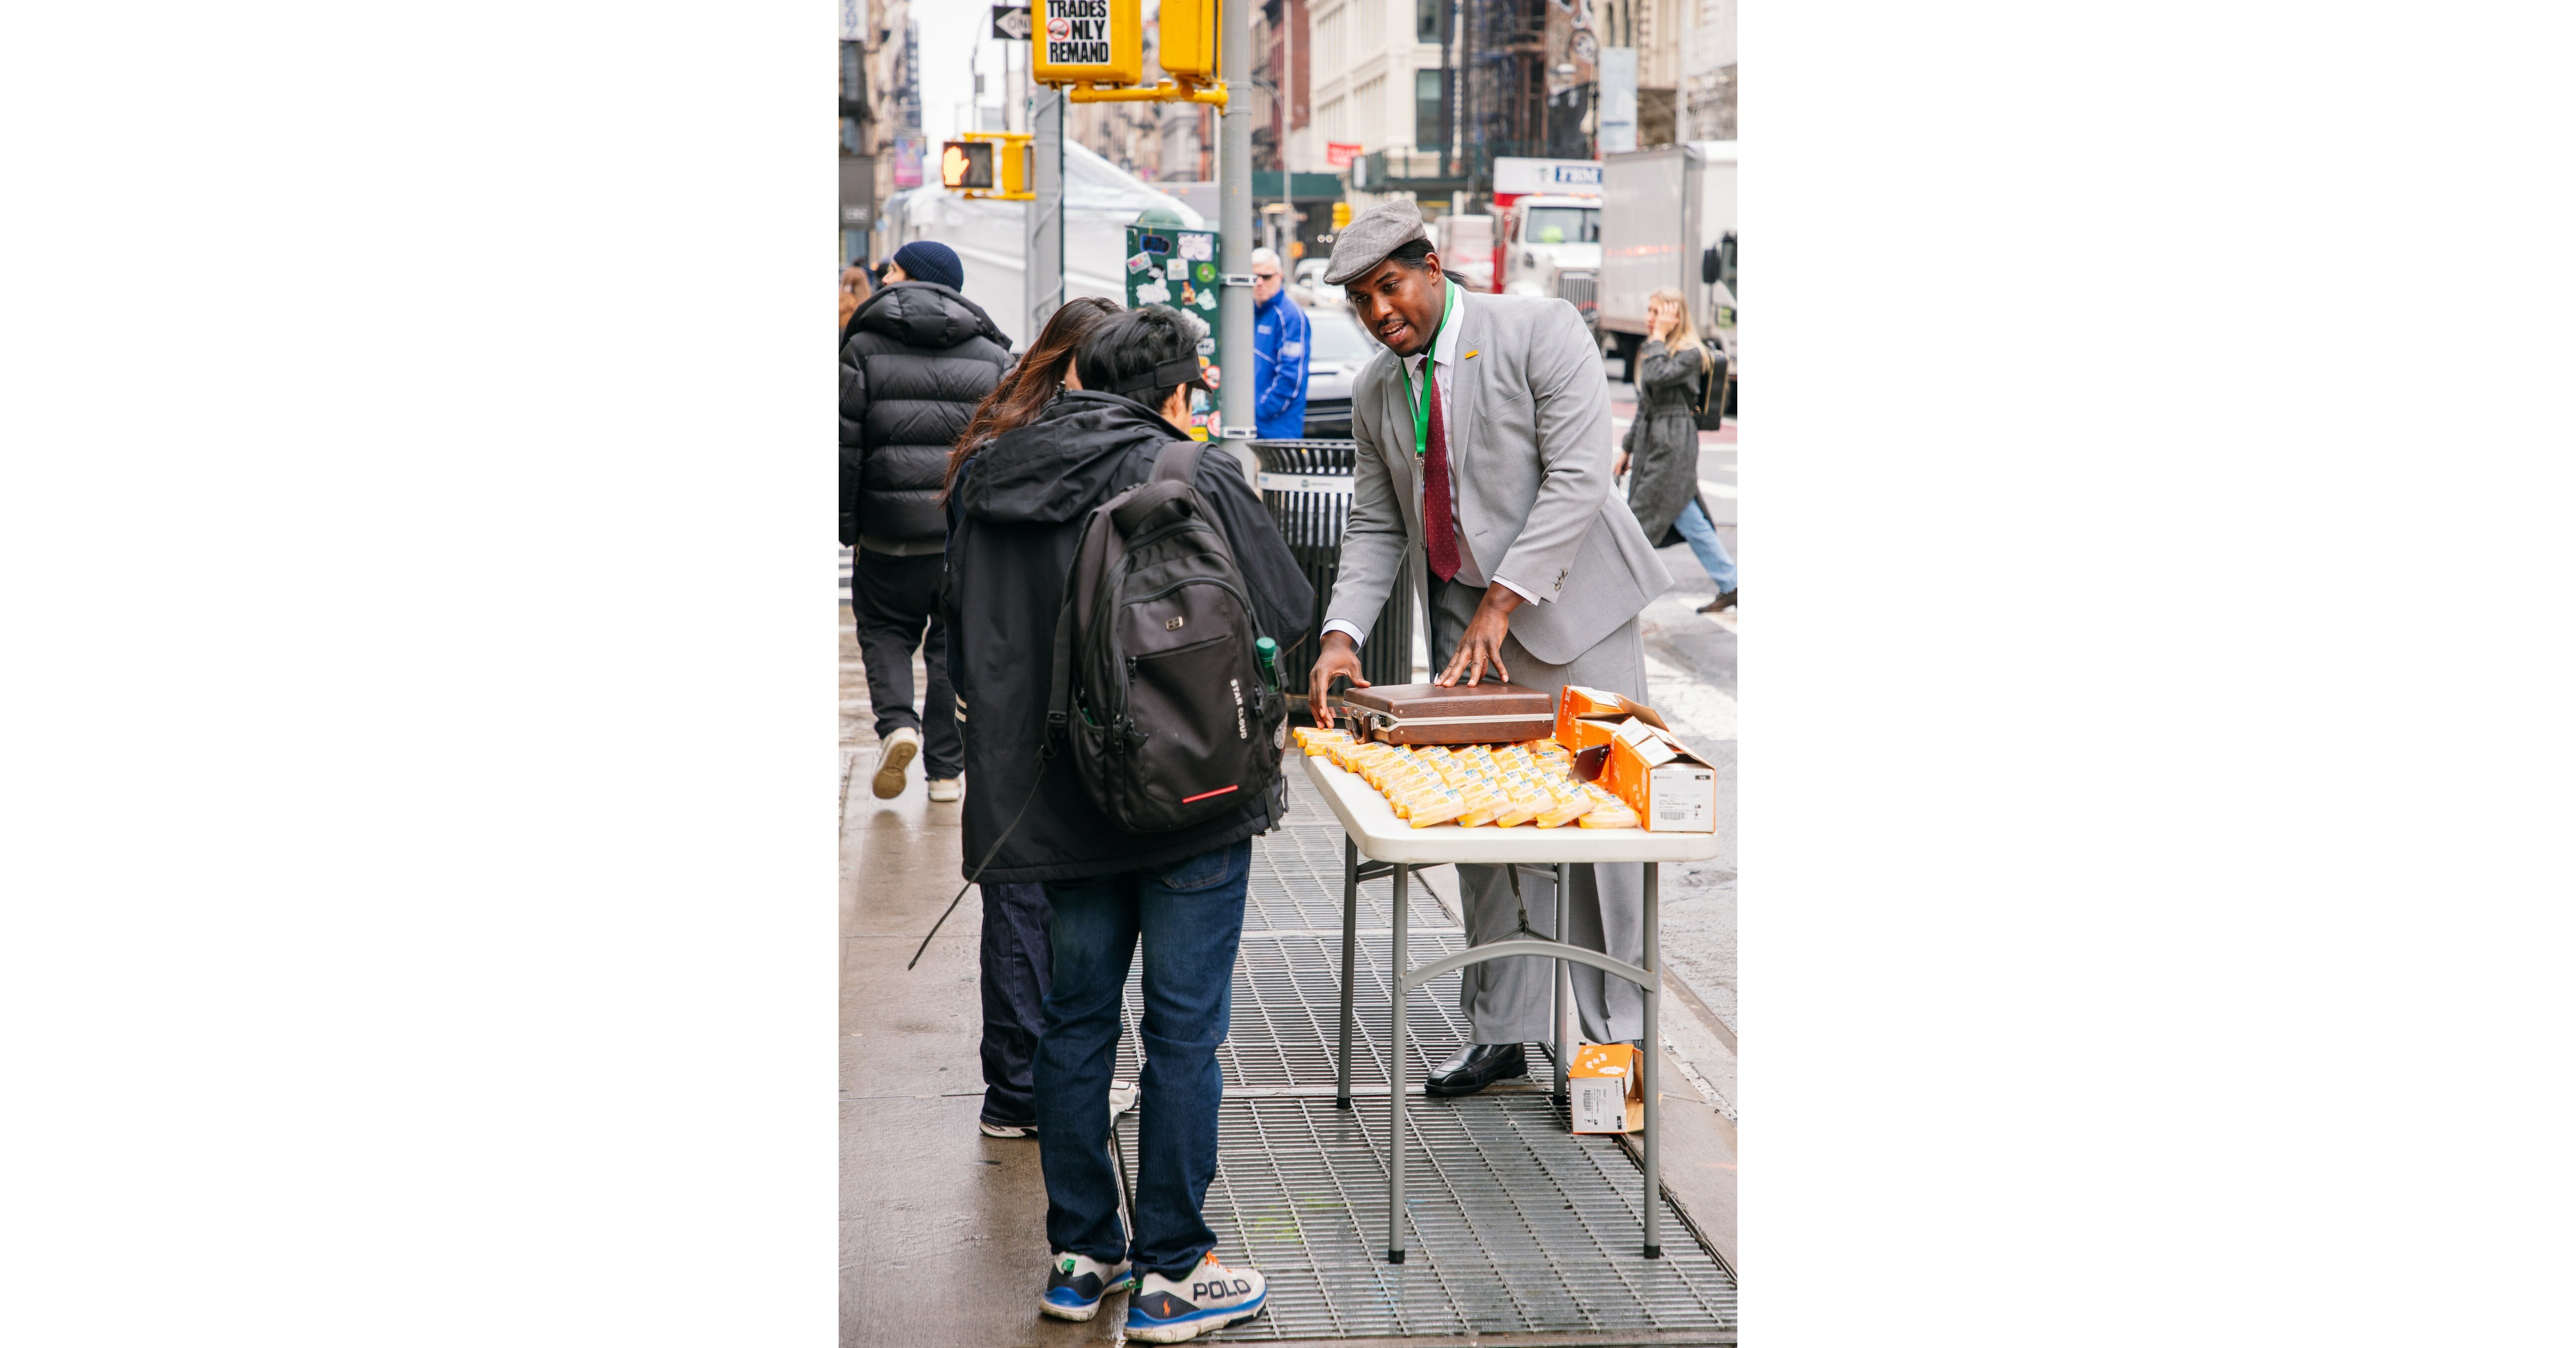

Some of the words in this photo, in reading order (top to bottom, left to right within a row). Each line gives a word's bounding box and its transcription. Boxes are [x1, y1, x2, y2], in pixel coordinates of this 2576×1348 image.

[1048, 0, 1106, 17] TRADES
[1007, 16, 1031, 31] ON
[1050, 42, 1108, 62] REMAND
[1230, 679, 1243, 705] STAR
[1238, 706, 1247, 739] CLOUD
[1193, 1279, 1251, 1302] POLO
